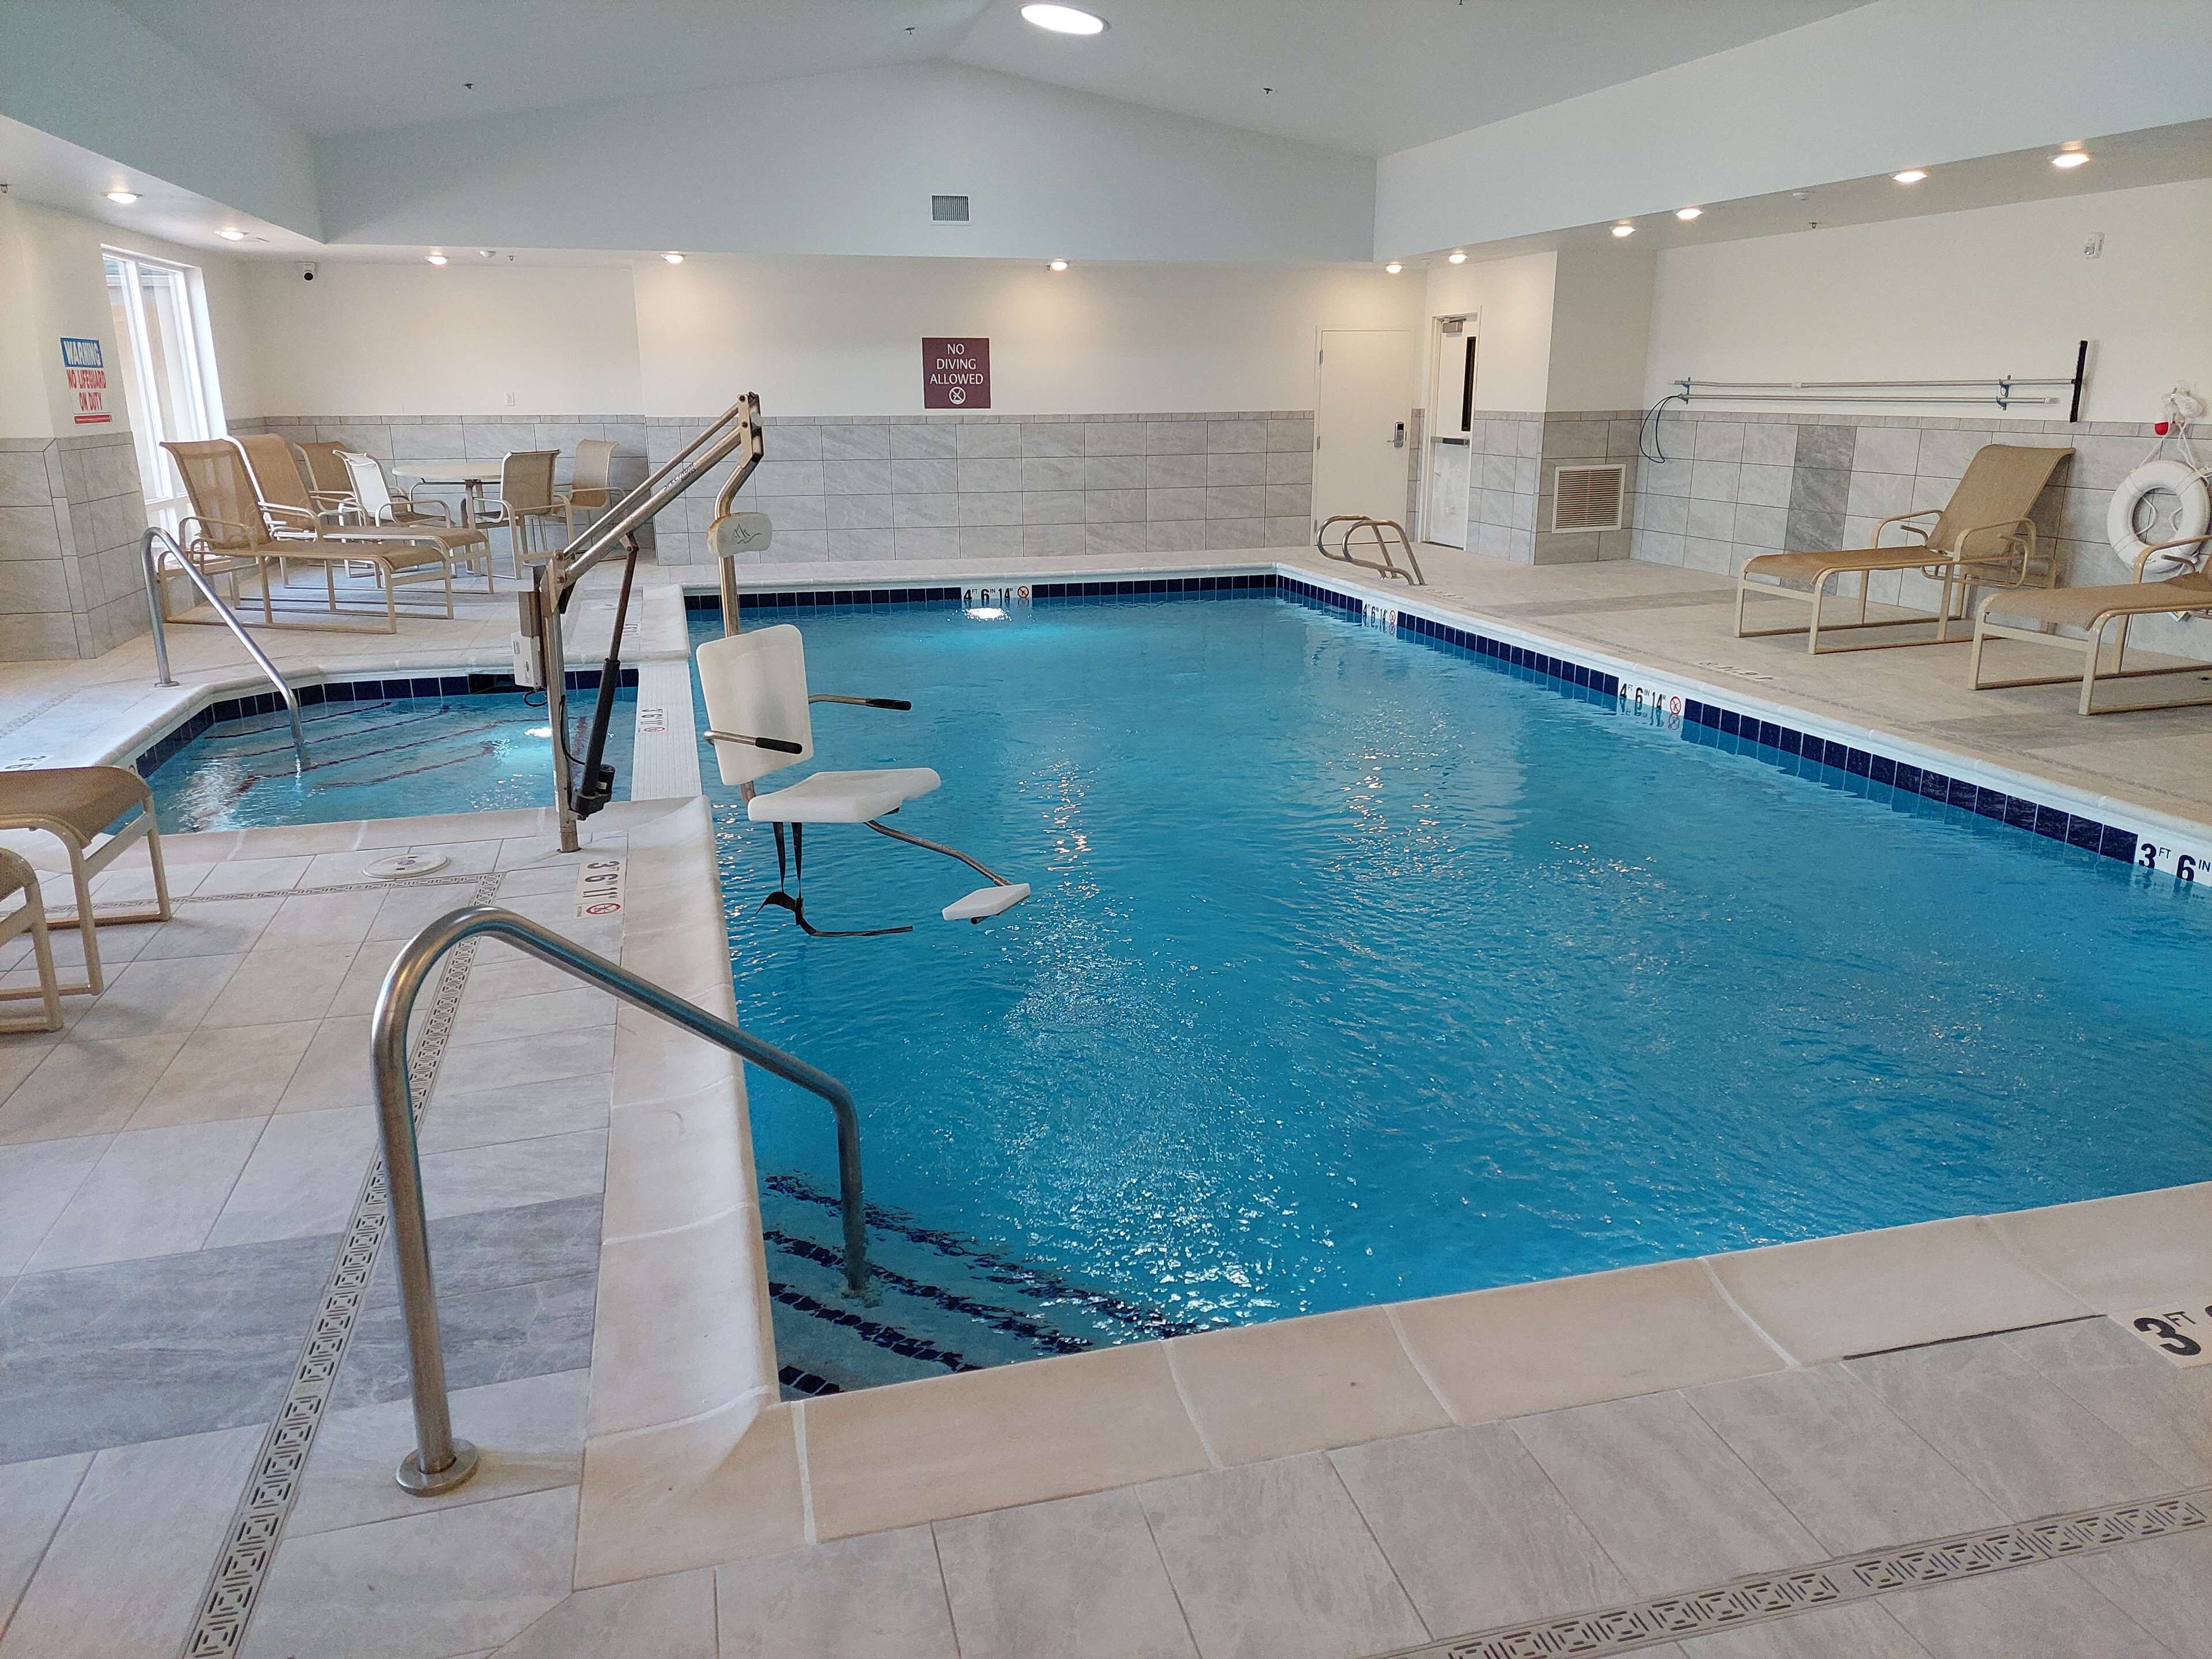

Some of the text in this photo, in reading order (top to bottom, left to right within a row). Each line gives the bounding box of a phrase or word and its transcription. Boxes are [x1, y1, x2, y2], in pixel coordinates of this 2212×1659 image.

[63, 340, 101, 366] WARNING
[947, 343, 965, 355] NO
[937, 358, 976, 370] DIVING
[67, 369, 106, 389] NO LIFEGUARD
[930, 373, 984, 385] ALLOWED
[79, 392, 103, 411] ON DUTY
